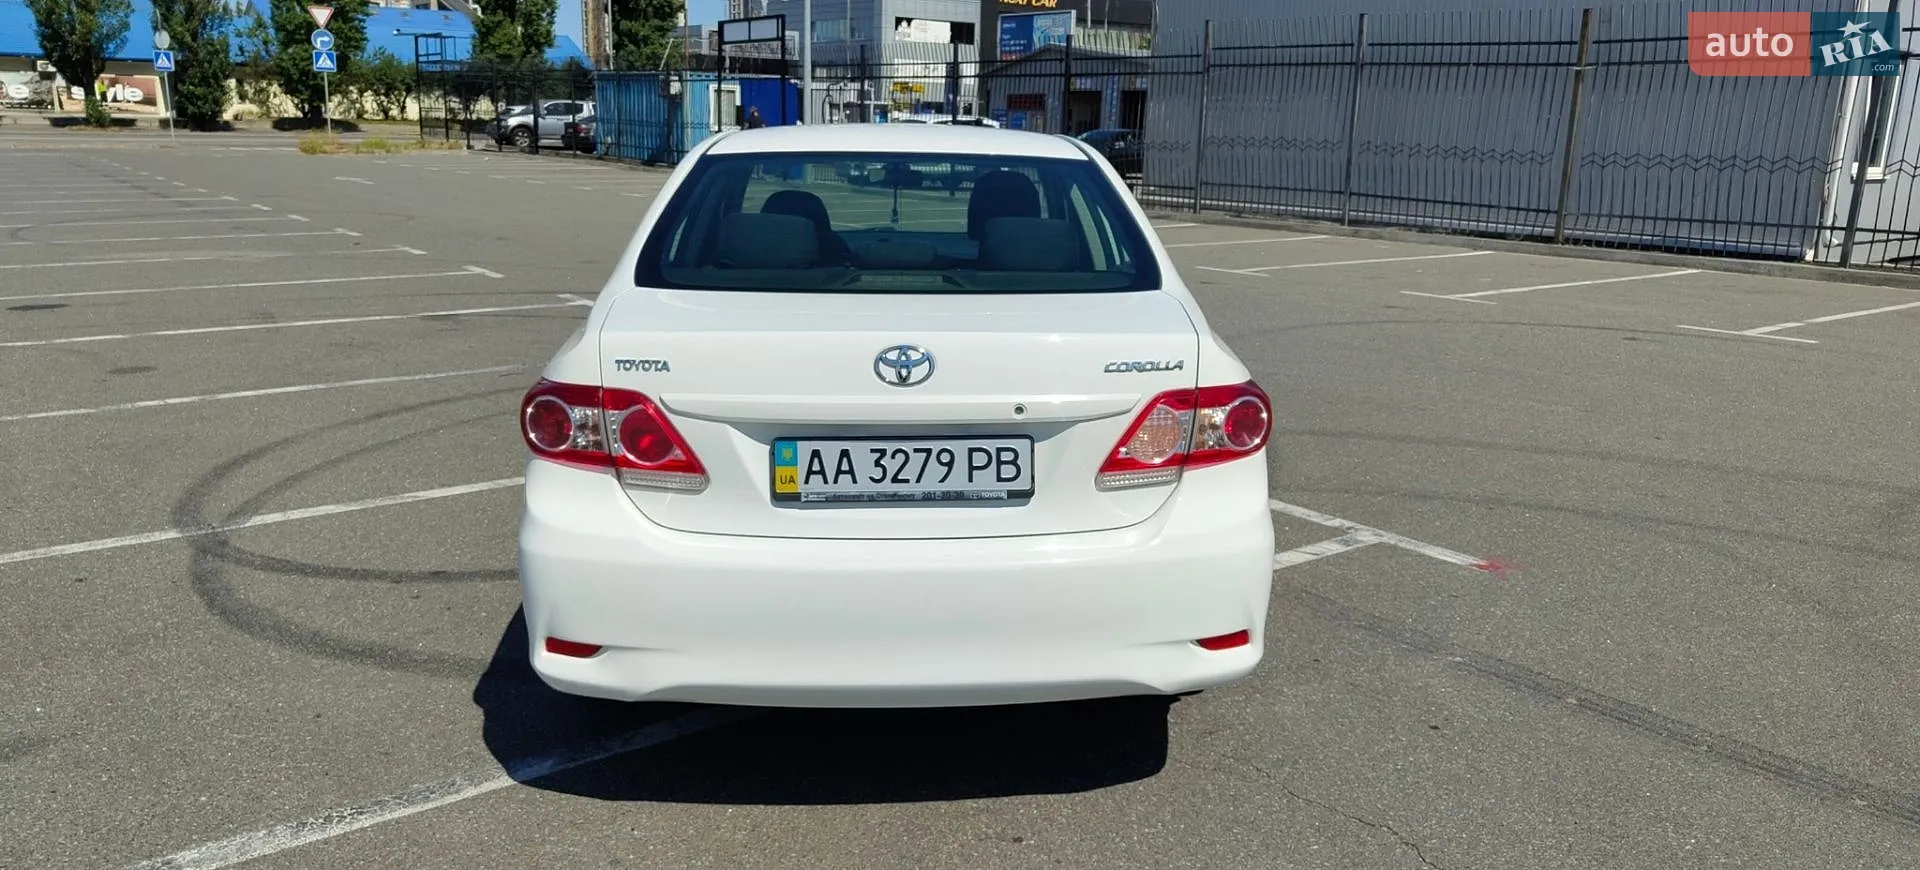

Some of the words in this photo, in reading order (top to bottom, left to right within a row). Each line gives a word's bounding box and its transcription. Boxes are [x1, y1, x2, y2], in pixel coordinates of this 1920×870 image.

[614, 359, 671, 373] TOYOTA
[1104, 359, 1185, 373] COROLLA
[803, 448, 858, 485] AA
[868, 447, 955, 484] 3279
[967, 446, 1022, 483] PB
[780, 475, 796, 485] UA
